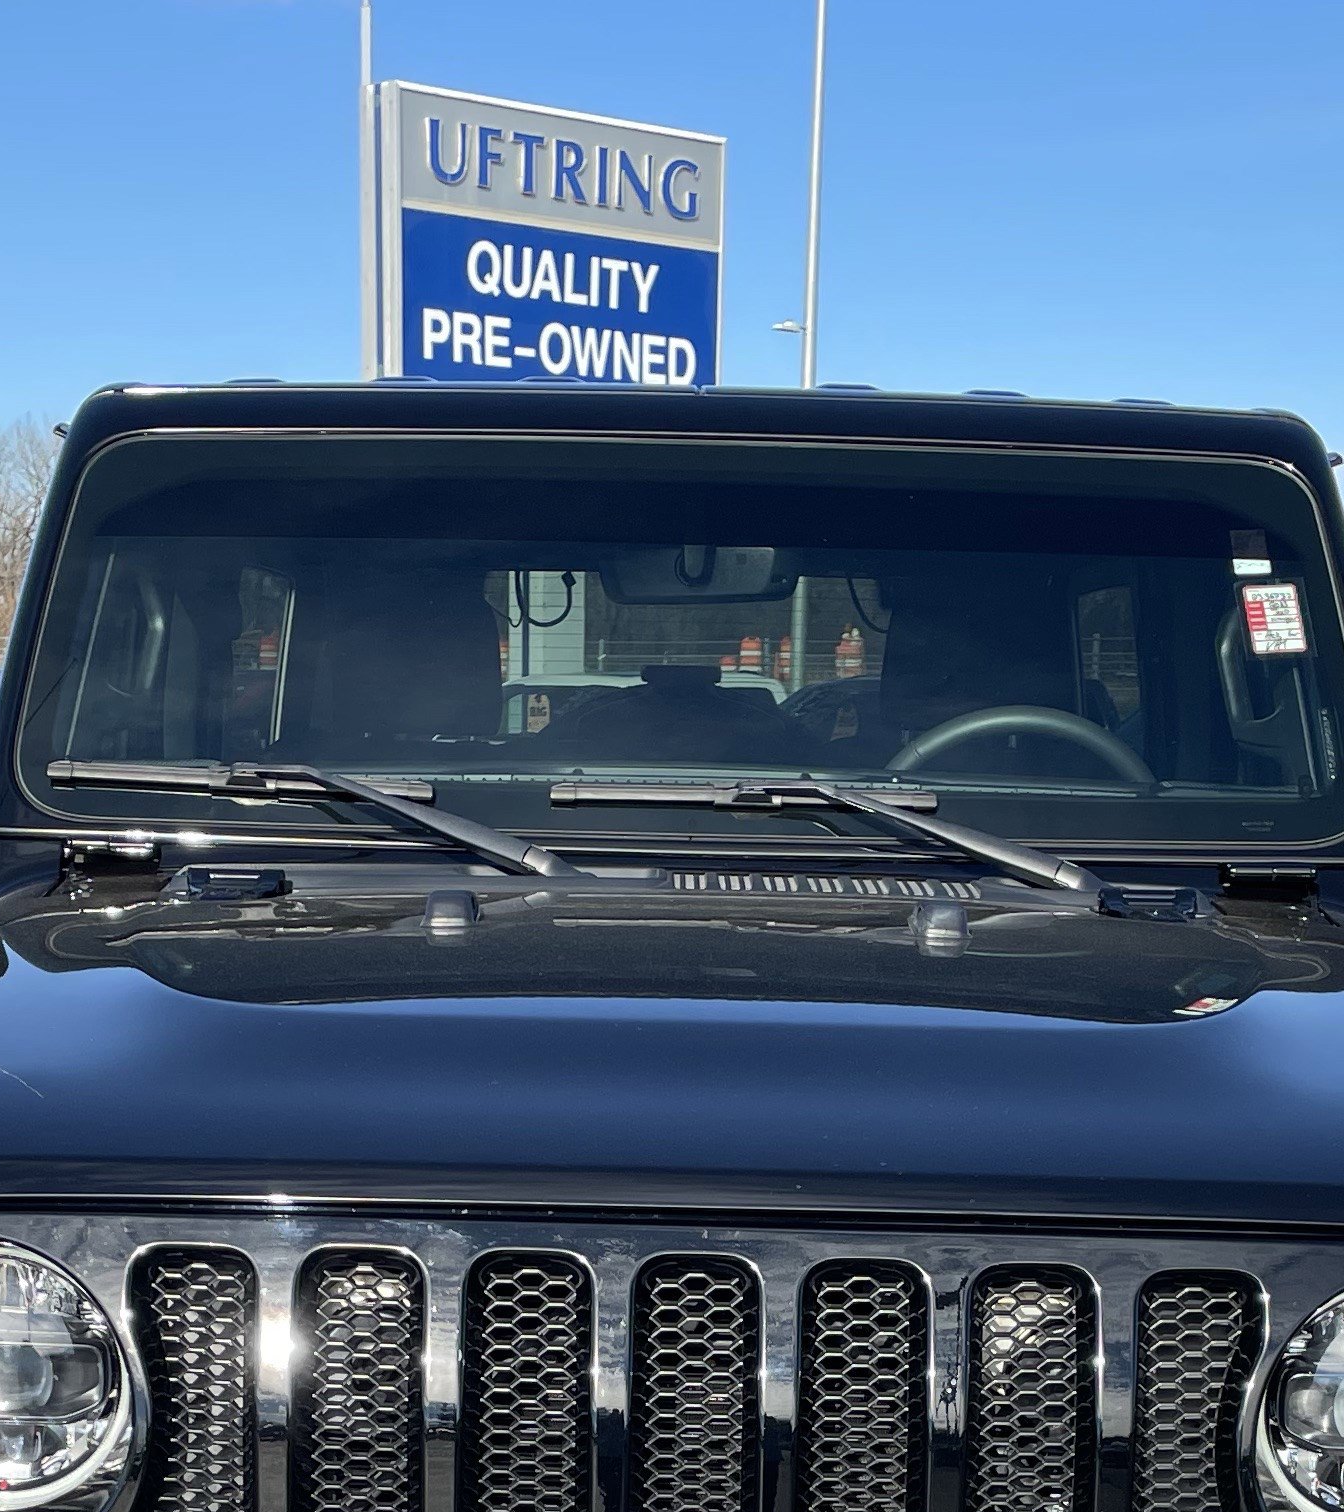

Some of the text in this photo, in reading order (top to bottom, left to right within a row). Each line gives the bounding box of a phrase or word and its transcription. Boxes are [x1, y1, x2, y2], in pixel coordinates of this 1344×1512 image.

[424, 116, 700, 221] UFTRING
[466, 240, 660, 313] QUALITY
[422, 308, 697, 386] PRE-OWNED
